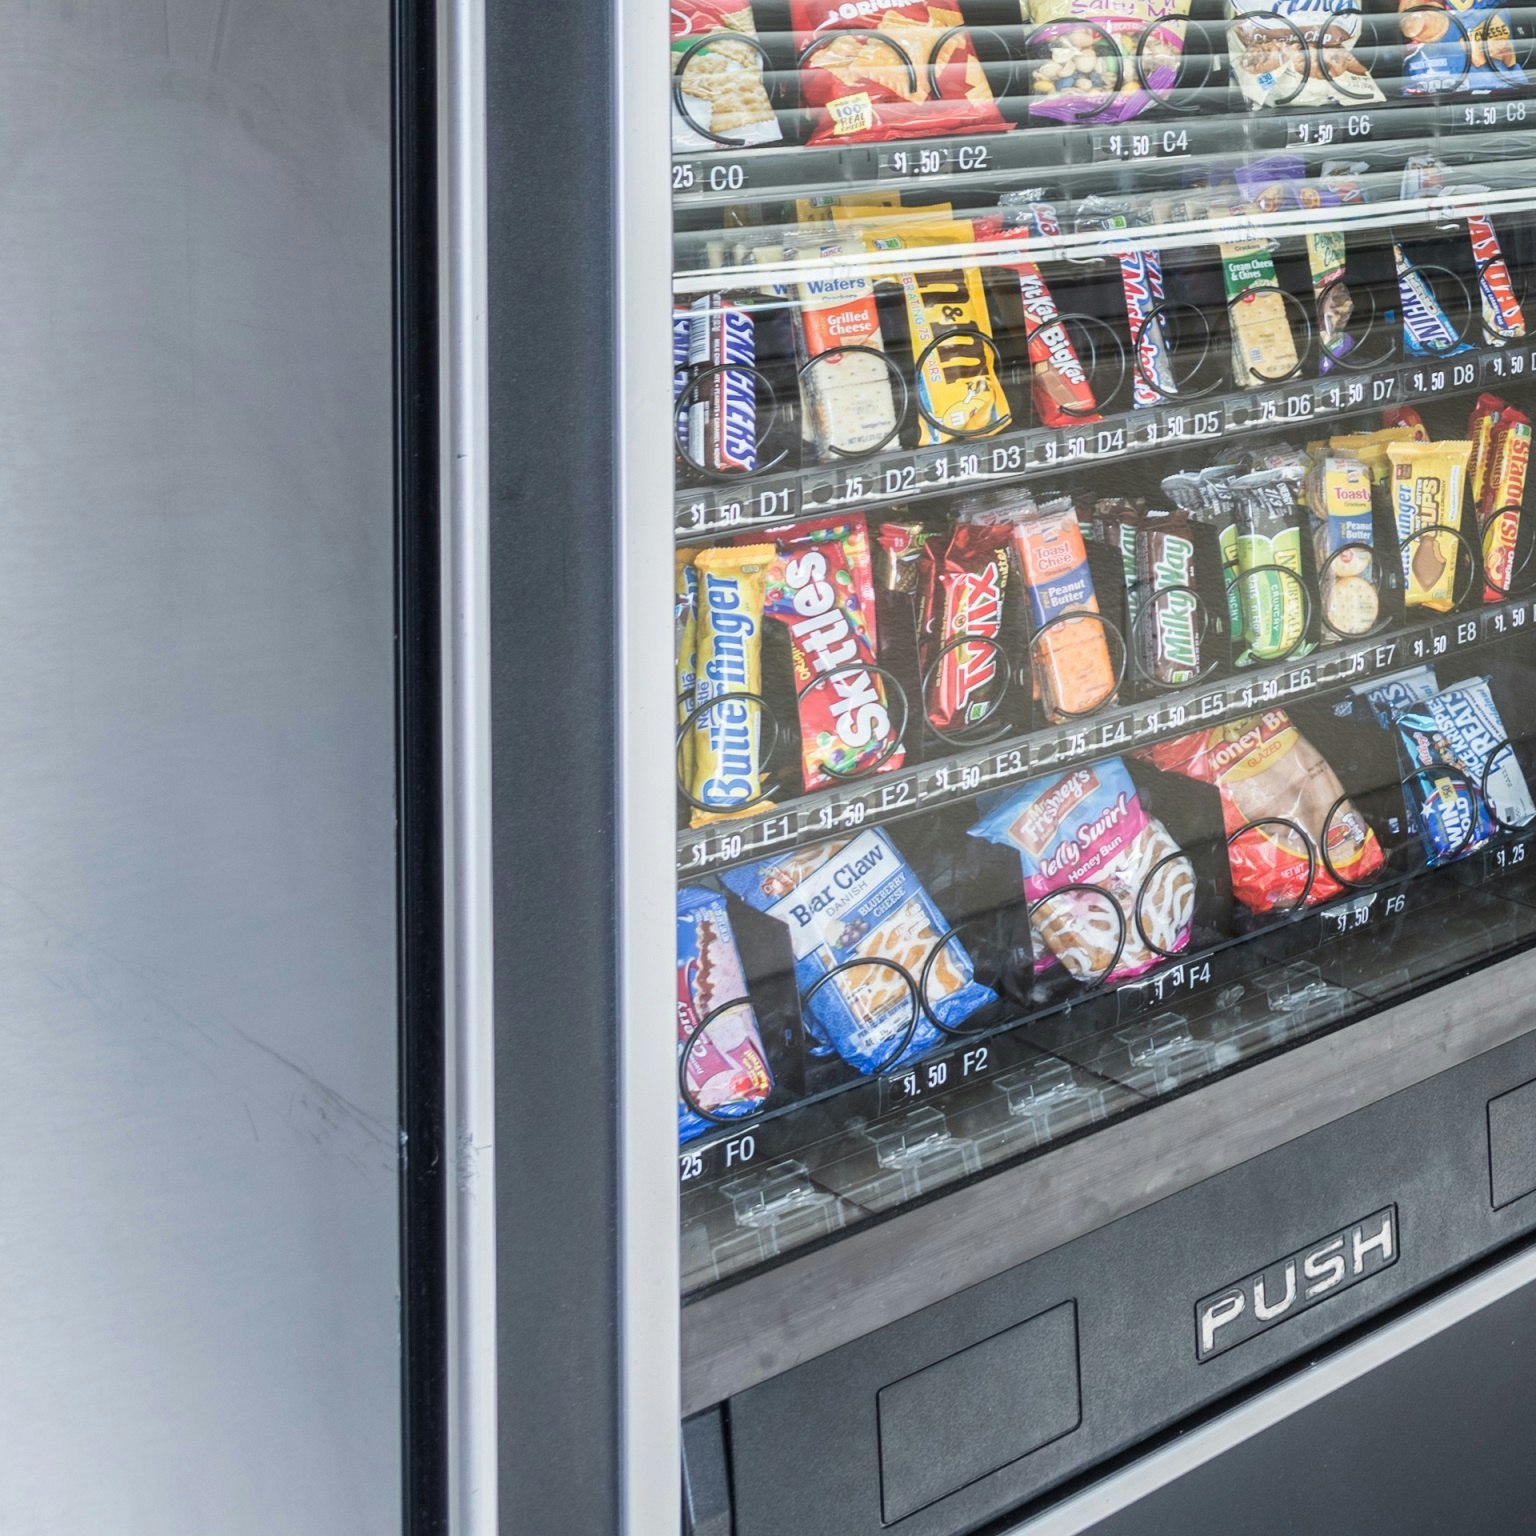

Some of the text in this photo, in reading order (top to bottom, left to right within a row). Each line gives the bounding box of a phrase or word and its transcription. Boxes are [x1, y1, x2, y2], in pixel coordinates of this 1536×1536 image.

[1506, 103, 1527, 122] C8
[1348, 116, 1370, 136] C6
[1163, 129, 1189, 153] C4
[959, 145, 987, 169] C2
[710, 165, 744, 191] C0
[1228, 259, 1274, 273] Cream Cheese
[1231, 269, 1262, 281] & Chives
[808, 277, 866, 295] Wafers
[827, 310, 869, 325] Grilled
[829, 322, 872, 336] Cheese
[1453, 364, 1474, 385] D8
[1373, 379, 1395, 400] D7
[1287, 395, 1311, 416] D6
[1194, 414, 1219, 435] D5
[1098, 432, 1124, 453] D4
[993, 446, 1022, 473] D3
[885, 466, 915, 493] D2
[760, 489, 790, 516] D1
[1346, 529, 1371, 540] Butter
[1035, 541, 1071, 560] Toast
[1038, 553, 1072, 571] Chee
[1048, 579, 1086, 597] Peanut
[1050, 589, 1085, 607] Butter
[1270, 584, 1280, 631] CRUNCHY
[1457, 622, 1477, 644] E8
[786, 551, 892, 747] Skittles
[1375, 646, 1396, 668] E7
[702, 573, 755, 807] Butterfinger
[1289, 669, 1312, 690] E6
[1201, 692, 1223, 714] E5
[1102, 724, 1126, 744] E4
[996, 751, 1022, 772] E3
[1247, 740, 1282, 768] GLAZED
[882, 783, 909, 808] E2
[763, 816, 789, 844] E1
[1041, 792, 1128, 878] Jelly Swirl
[834, 845, 885, 888] Claw
[1067, 836, 1123, 883] Honey Bun
[825, 880, 869, 918] DANISH
[859, 871, 906, 917] BLUEBERRY
[874, 886, 907, 919] CHEESE
[1385, 893, 1405, 917] F6
[1189, 962, 1211, 989] F4
[963, 1047, 988, 1076] F2
[726, 1135, 755, 1168] F0
[1201, 1210, 1393, 1353] PUSH
